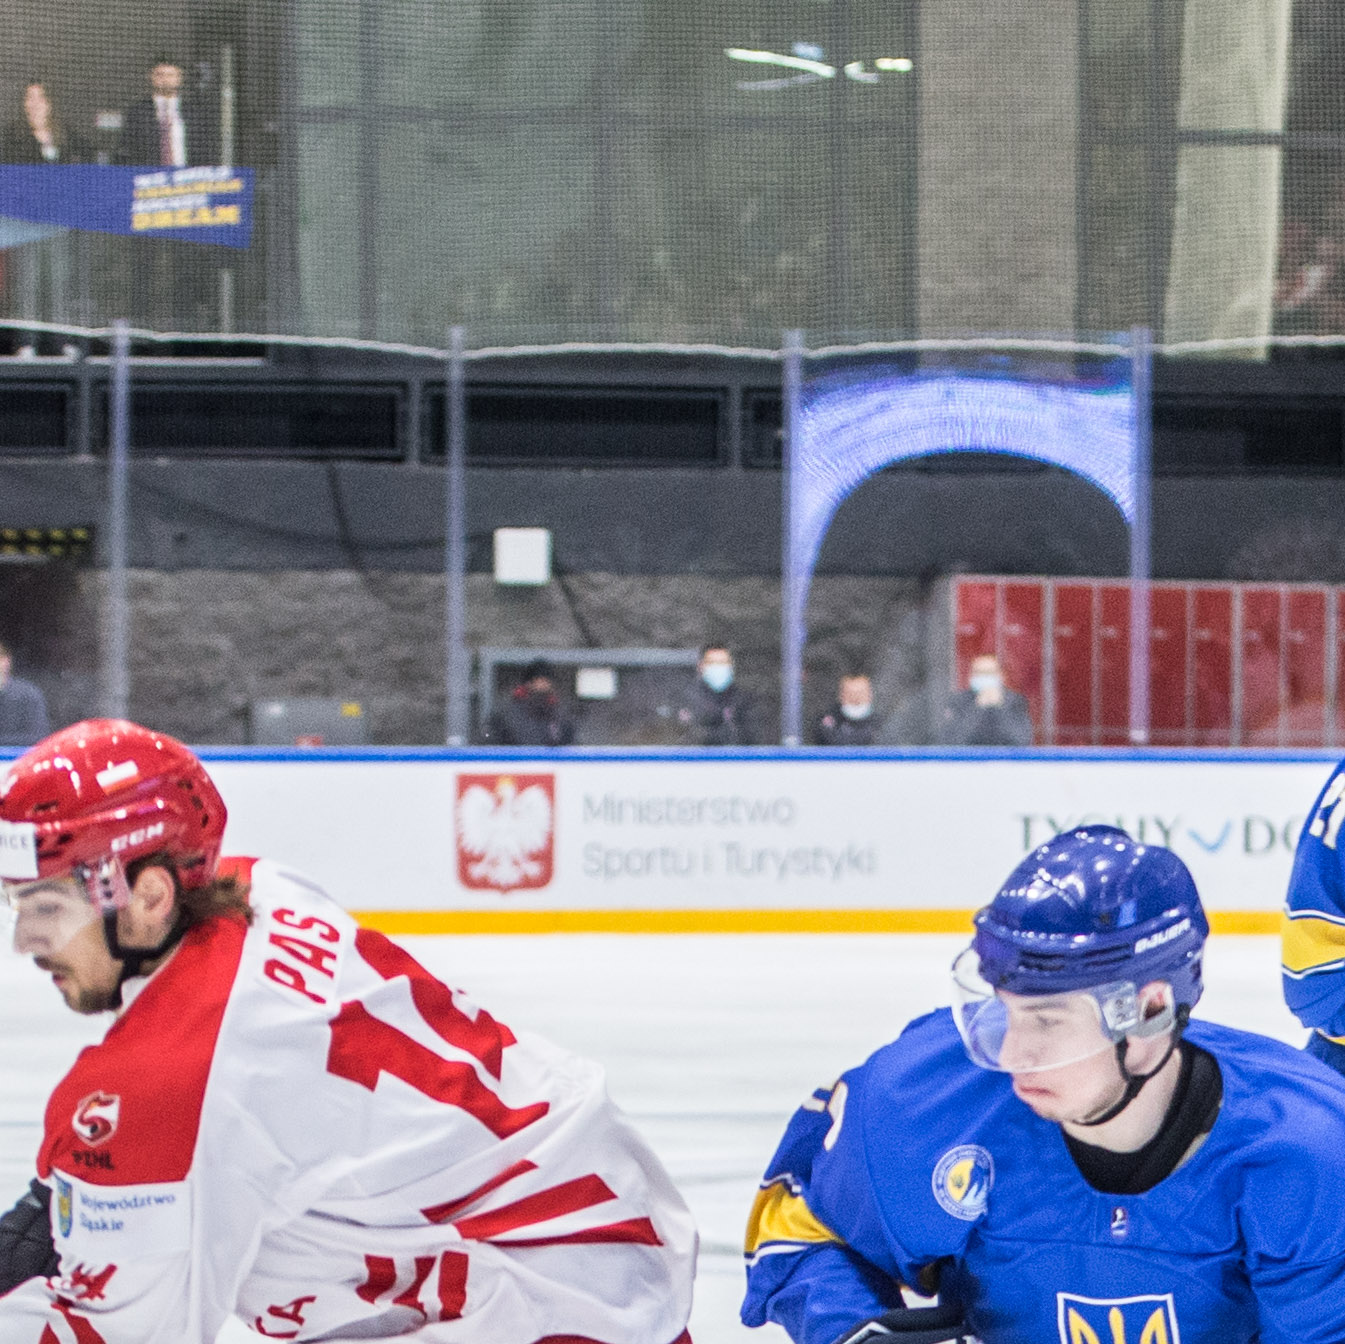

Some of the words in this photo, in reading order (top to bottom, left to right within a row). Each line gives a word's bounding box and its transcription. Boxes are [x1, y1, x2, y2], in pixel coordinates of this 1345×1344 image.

[582, 793, 796, 825] Ministerstwo
[582, 841, 694, 882] Sportu
[720, 841, 879, 882] Turystyki
[262, 907, 342, 1005] PAS
